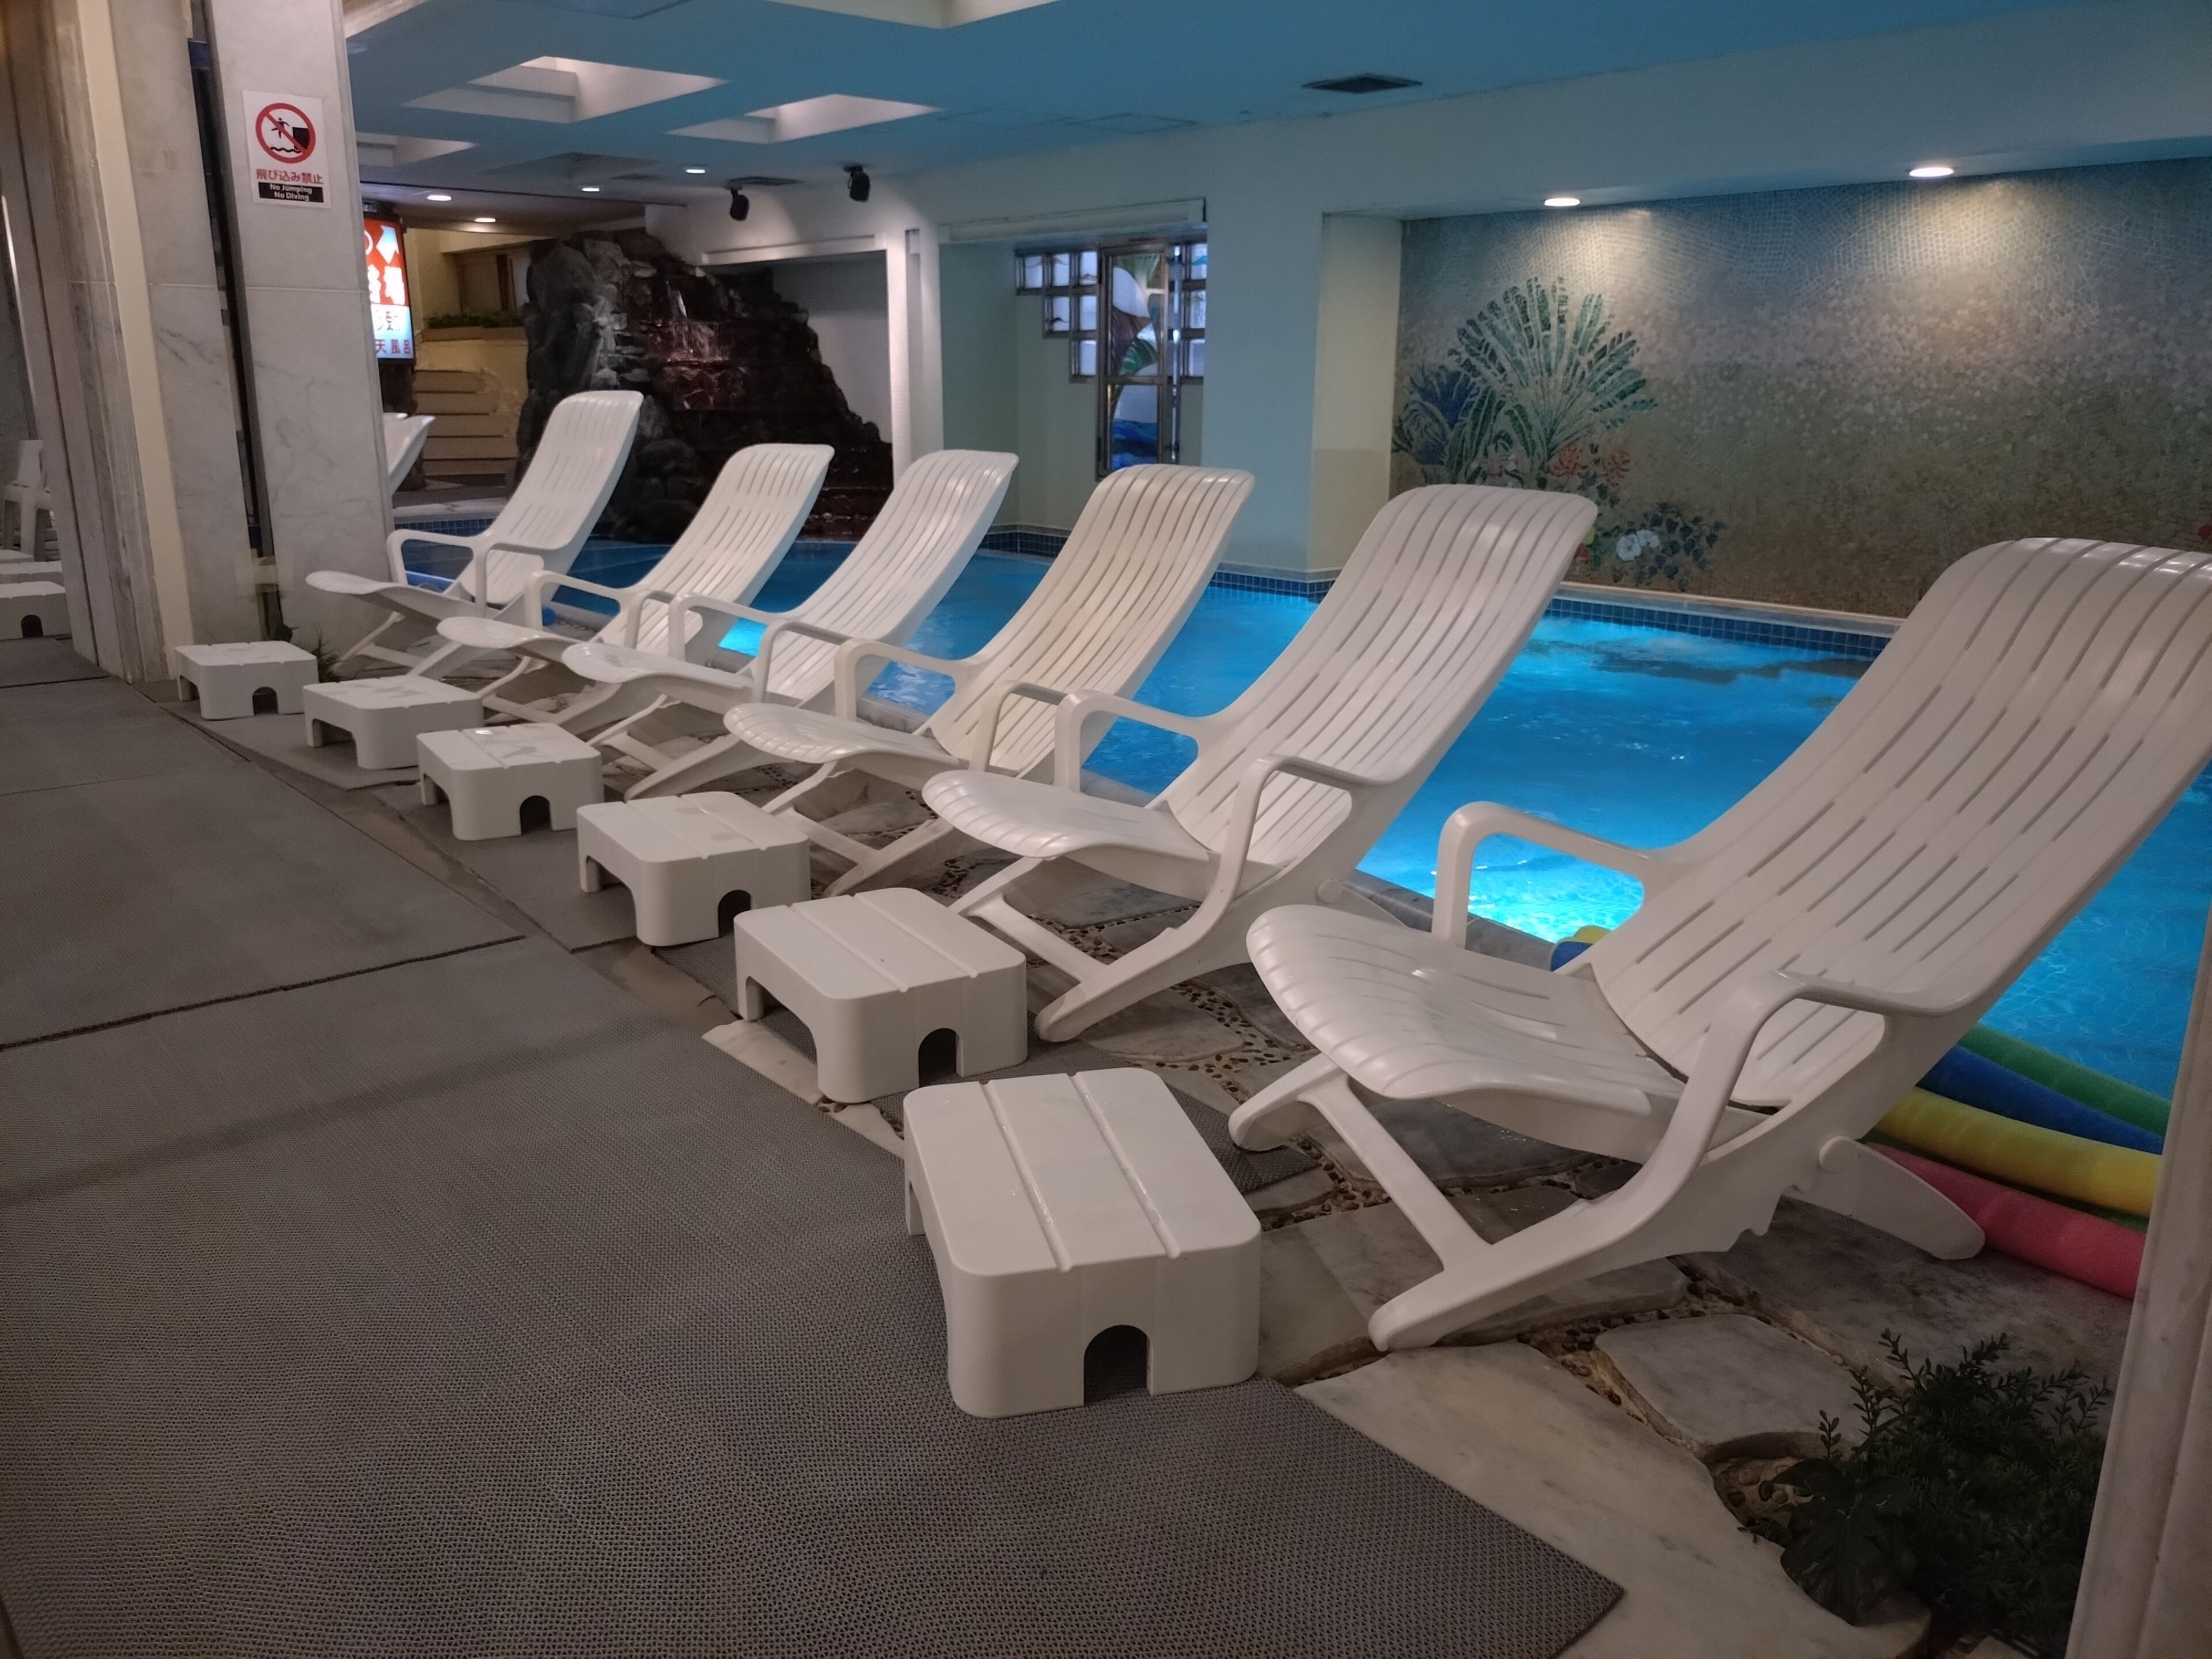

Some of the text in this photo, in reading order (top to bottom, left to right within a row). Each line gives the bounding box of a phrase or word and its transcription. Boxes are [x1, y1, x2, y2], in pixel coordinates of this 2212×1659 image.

[256, 168, 323, 184] 飛び込み禁止
[282, 185, 312, 194] Jumping
[286, 192, 309, 201] Diving
